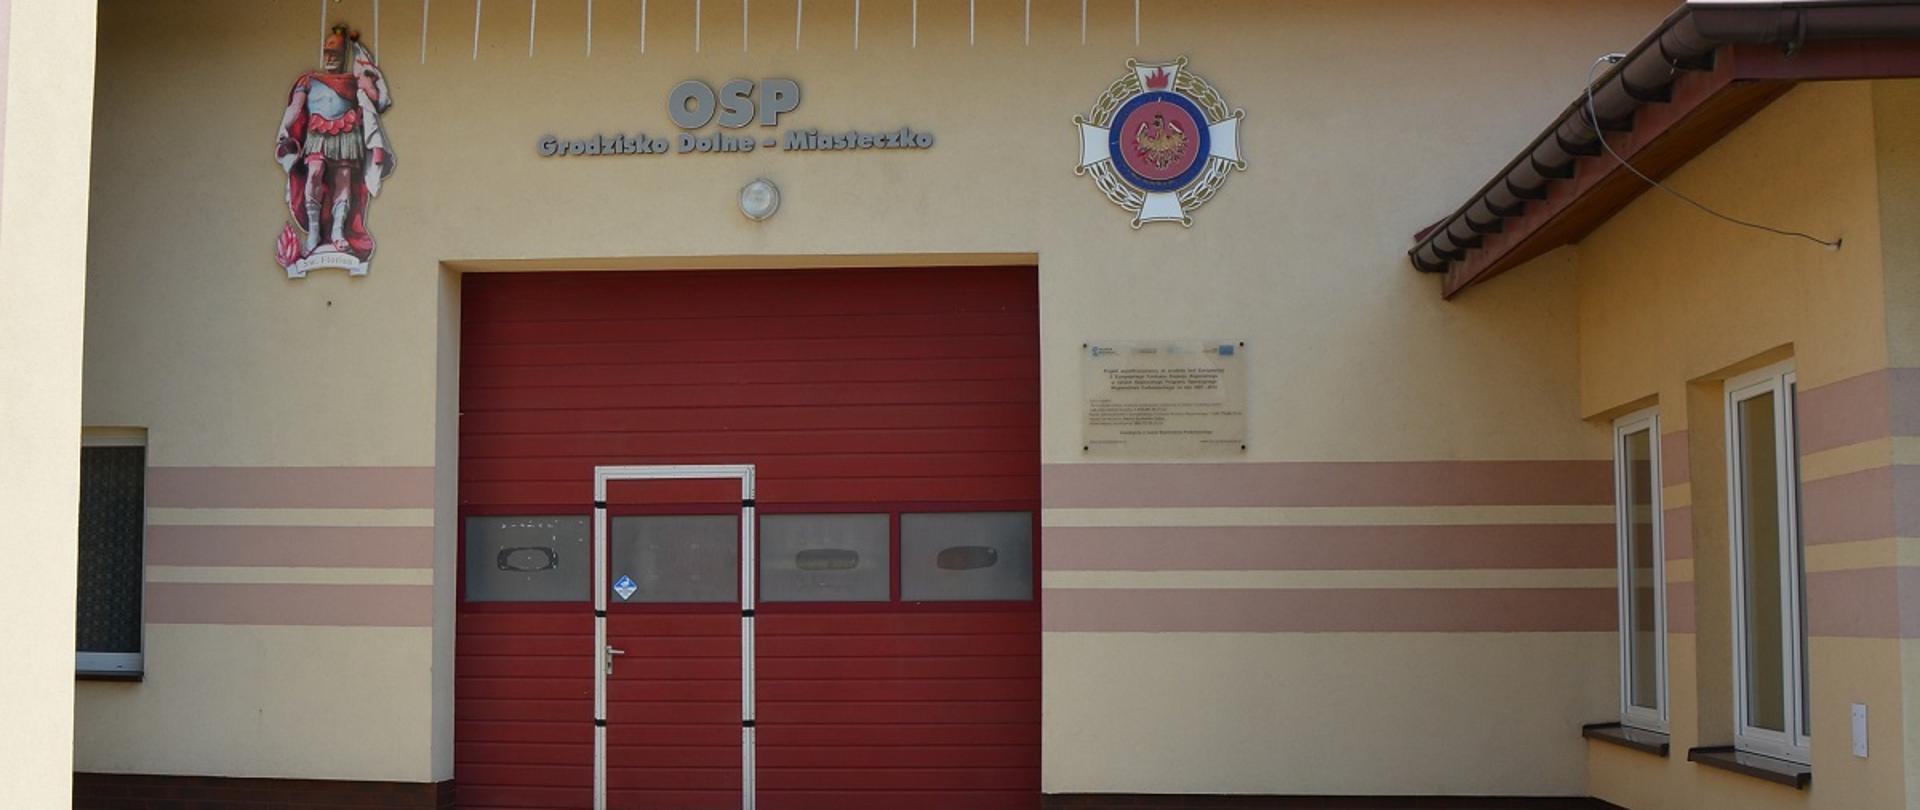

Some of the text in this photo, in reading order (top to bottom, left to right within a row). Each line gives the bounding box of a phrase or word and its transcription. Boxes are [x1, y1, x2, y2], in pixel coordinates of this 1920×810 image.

[668, 78, 801, 129] OSP
[539, 132, 669, 156] Grodzisko
[678, 131, 755, 153] Dolne
[784, 127, 934, 151] Miasteczko
